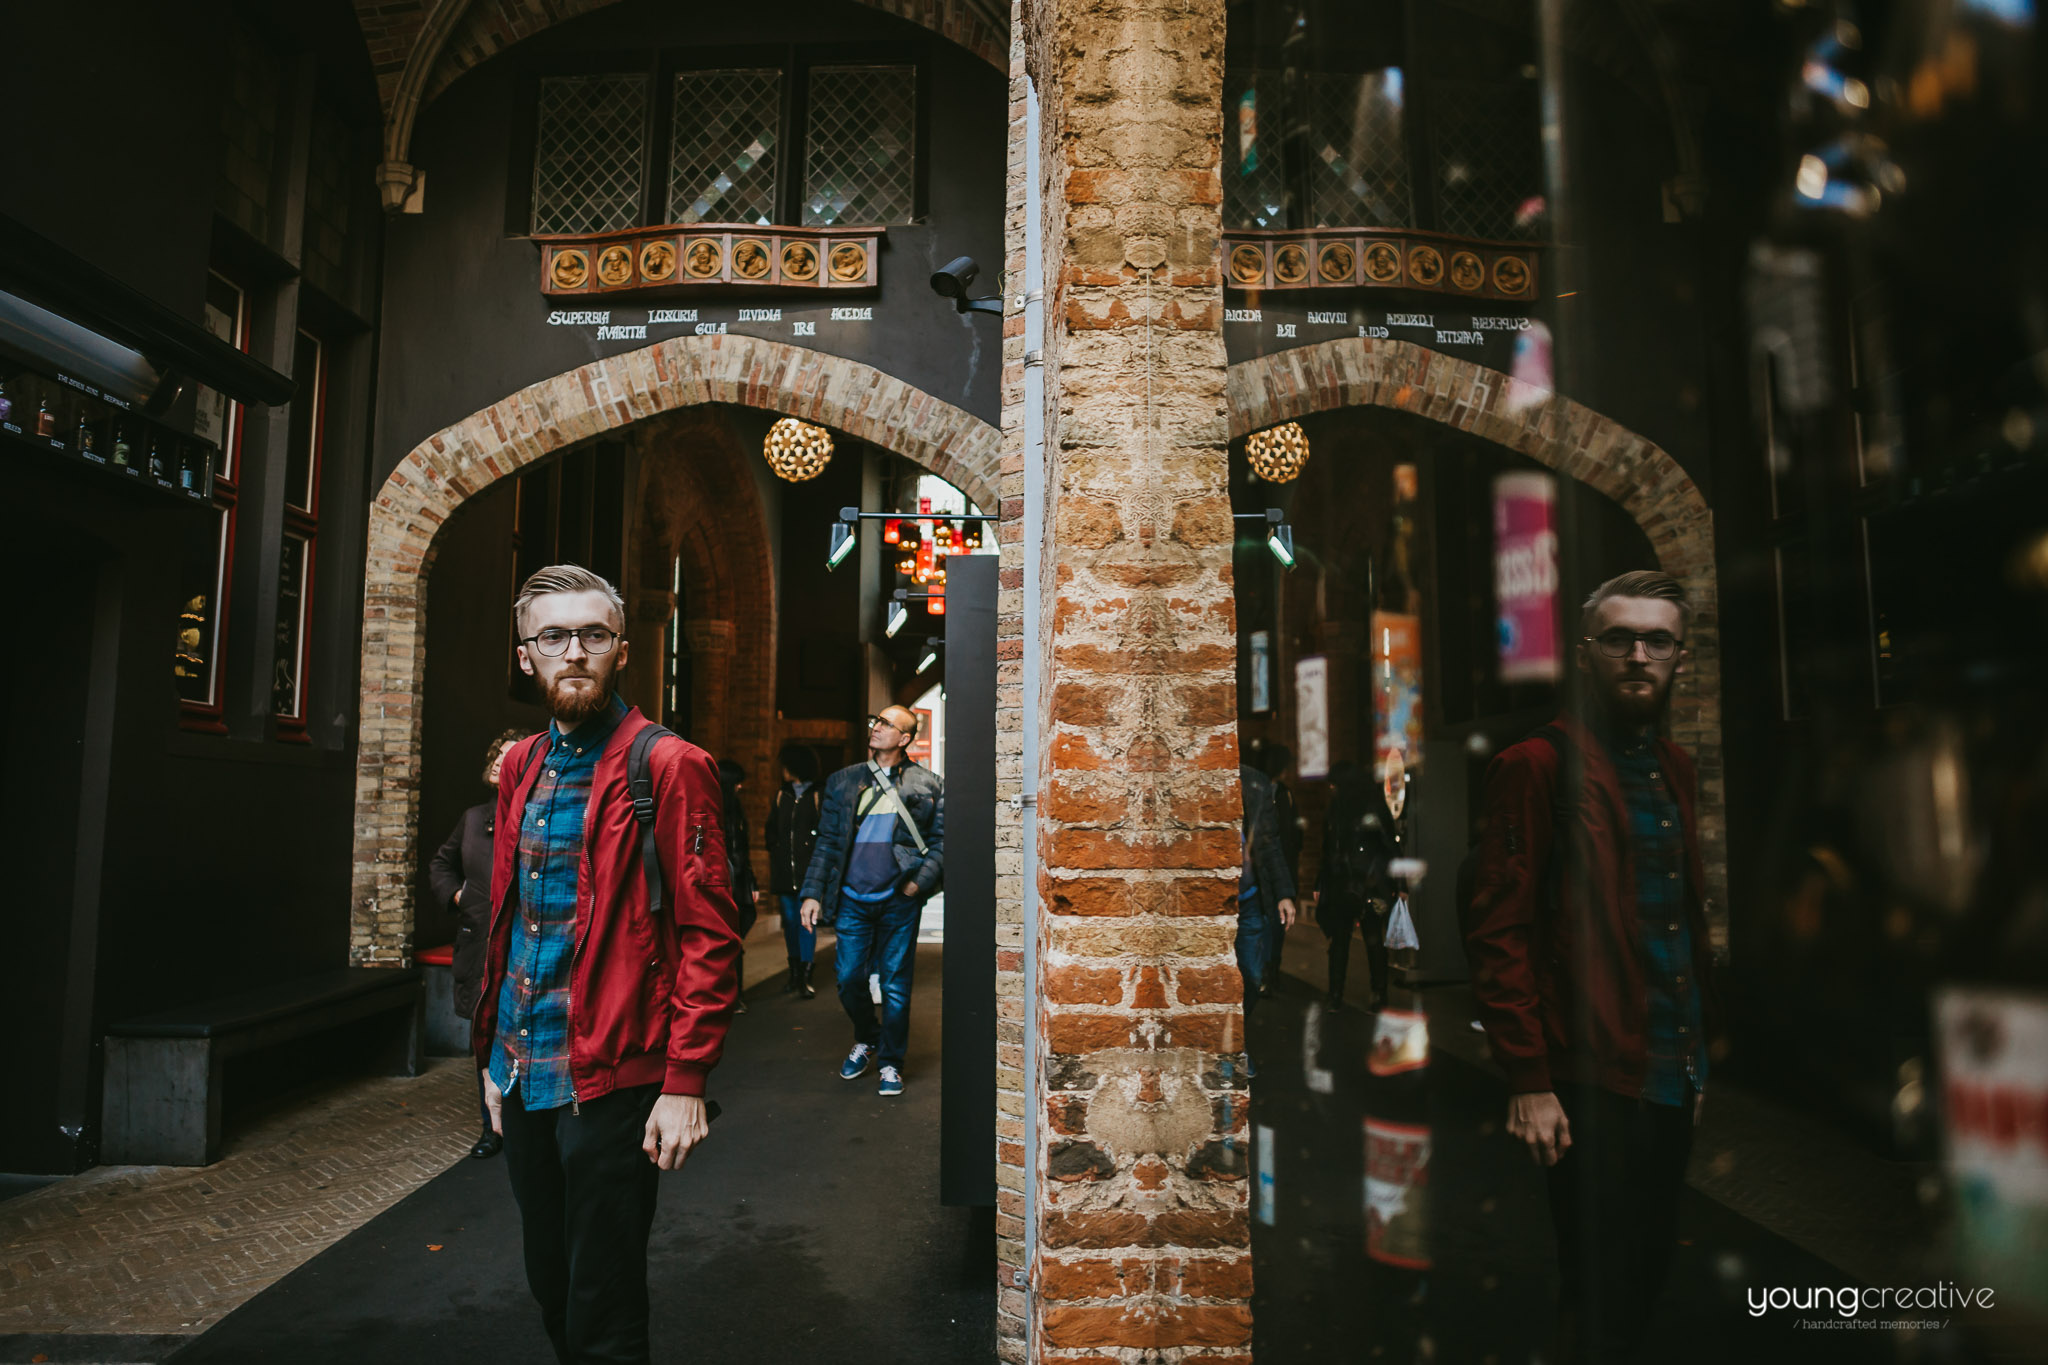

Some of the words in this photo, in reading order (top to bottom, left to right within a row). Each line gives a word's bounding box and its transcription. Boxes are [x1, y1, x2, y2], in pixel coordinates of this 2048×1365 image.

[547, 311, 610, 325] SUPERBIA
[648, 310, 698, 323] LUXURIA
[738, 309, 782, 321] INVIDIA
[831, 308, 872, 320] ACEDIA
[597, 326, 646, 340] AVARITIA
[695, 323, 727, 335] GULA
[793, 322, 815, 335] IRA
